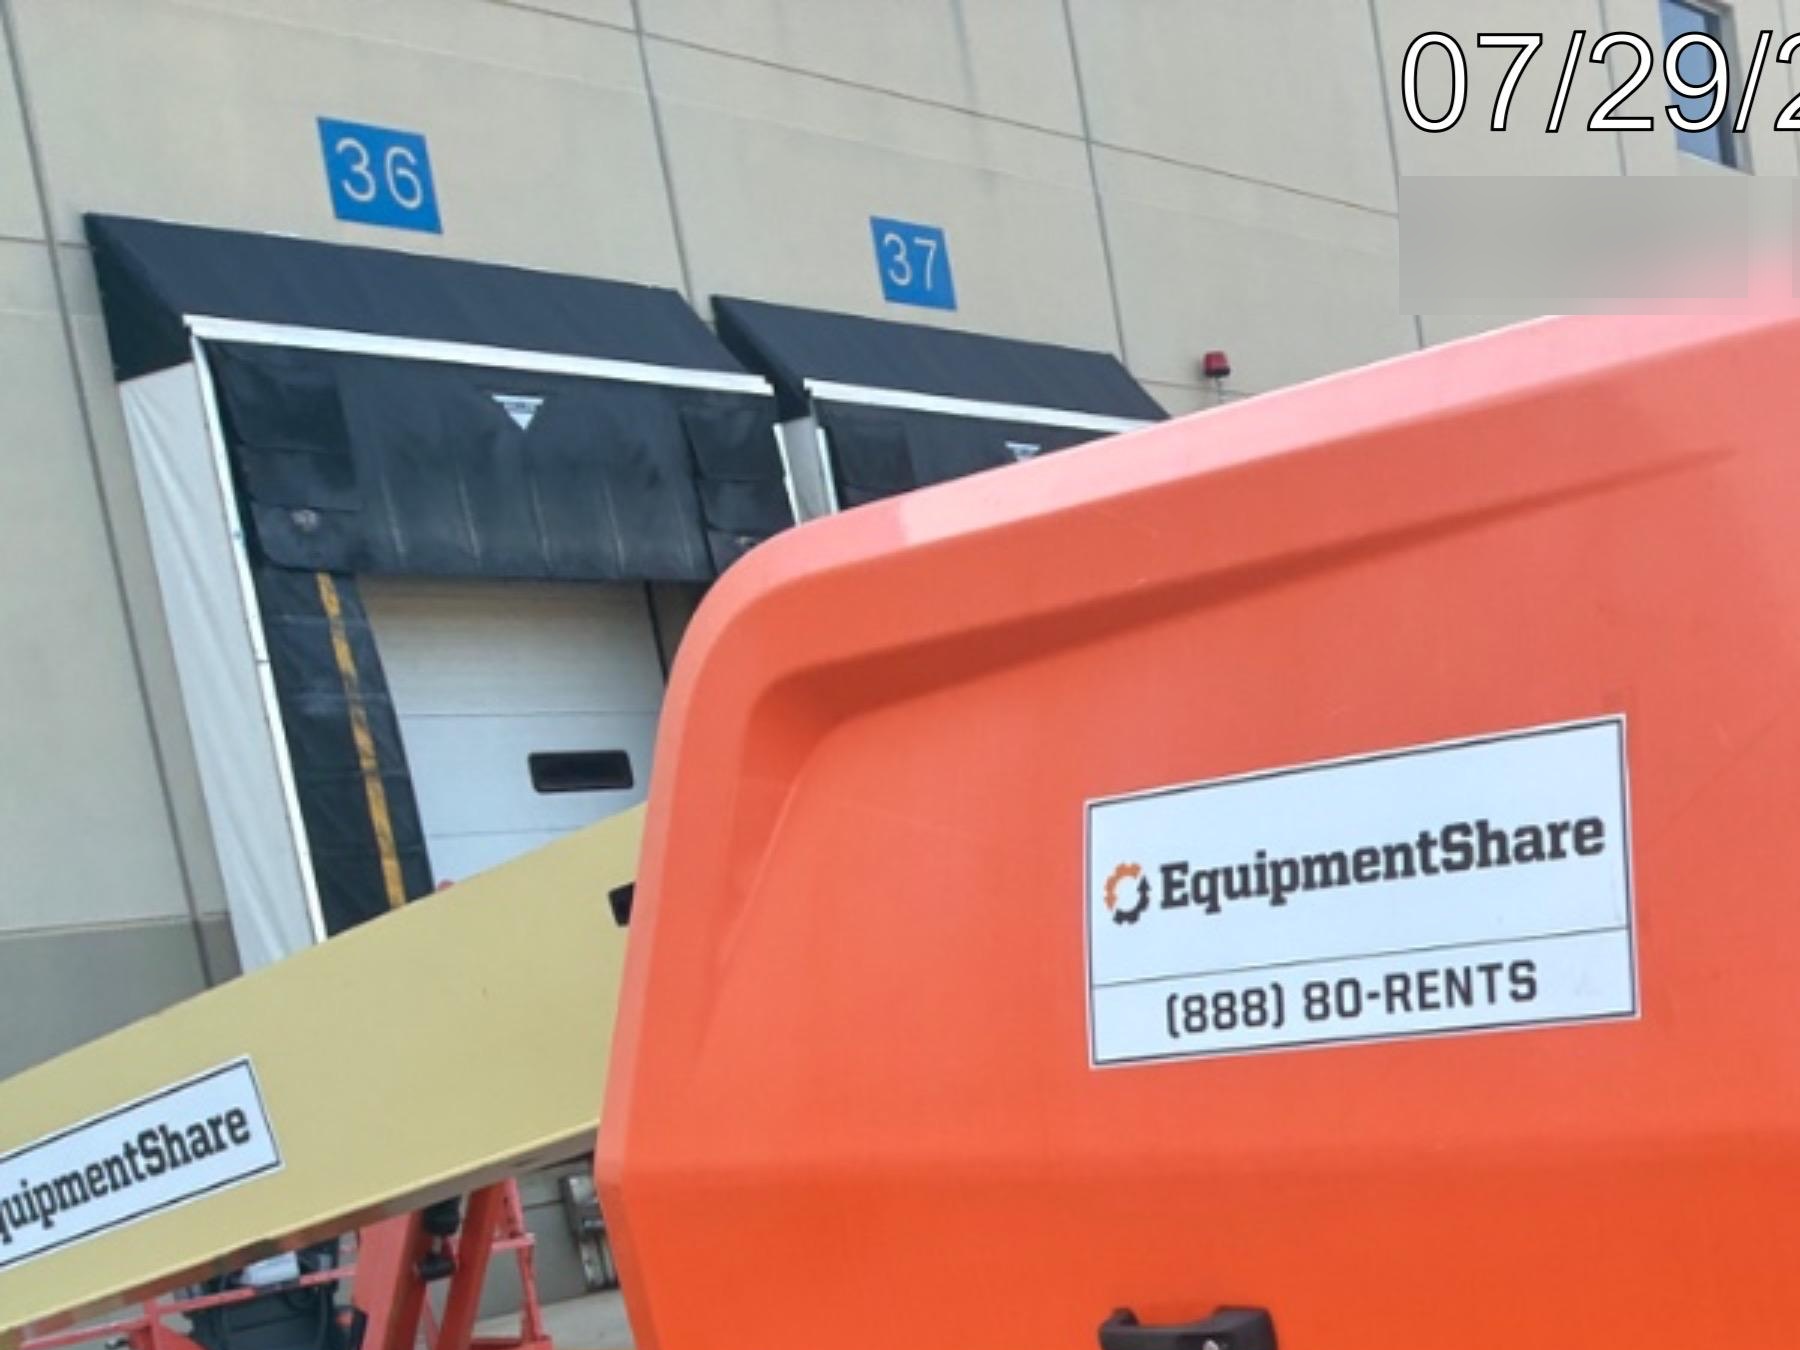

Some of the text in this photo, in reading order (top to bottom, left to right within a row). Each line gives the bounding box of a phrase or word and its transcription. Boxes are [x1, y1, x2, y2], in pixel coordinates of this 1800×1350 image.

[334, 136, 424, 211] 36
[883, 231, 937, 292] 37
[1160, 814, 1605, 915] EquipmentShare
[1166, 959, 1538, 1039] (888) 80-RENTS
